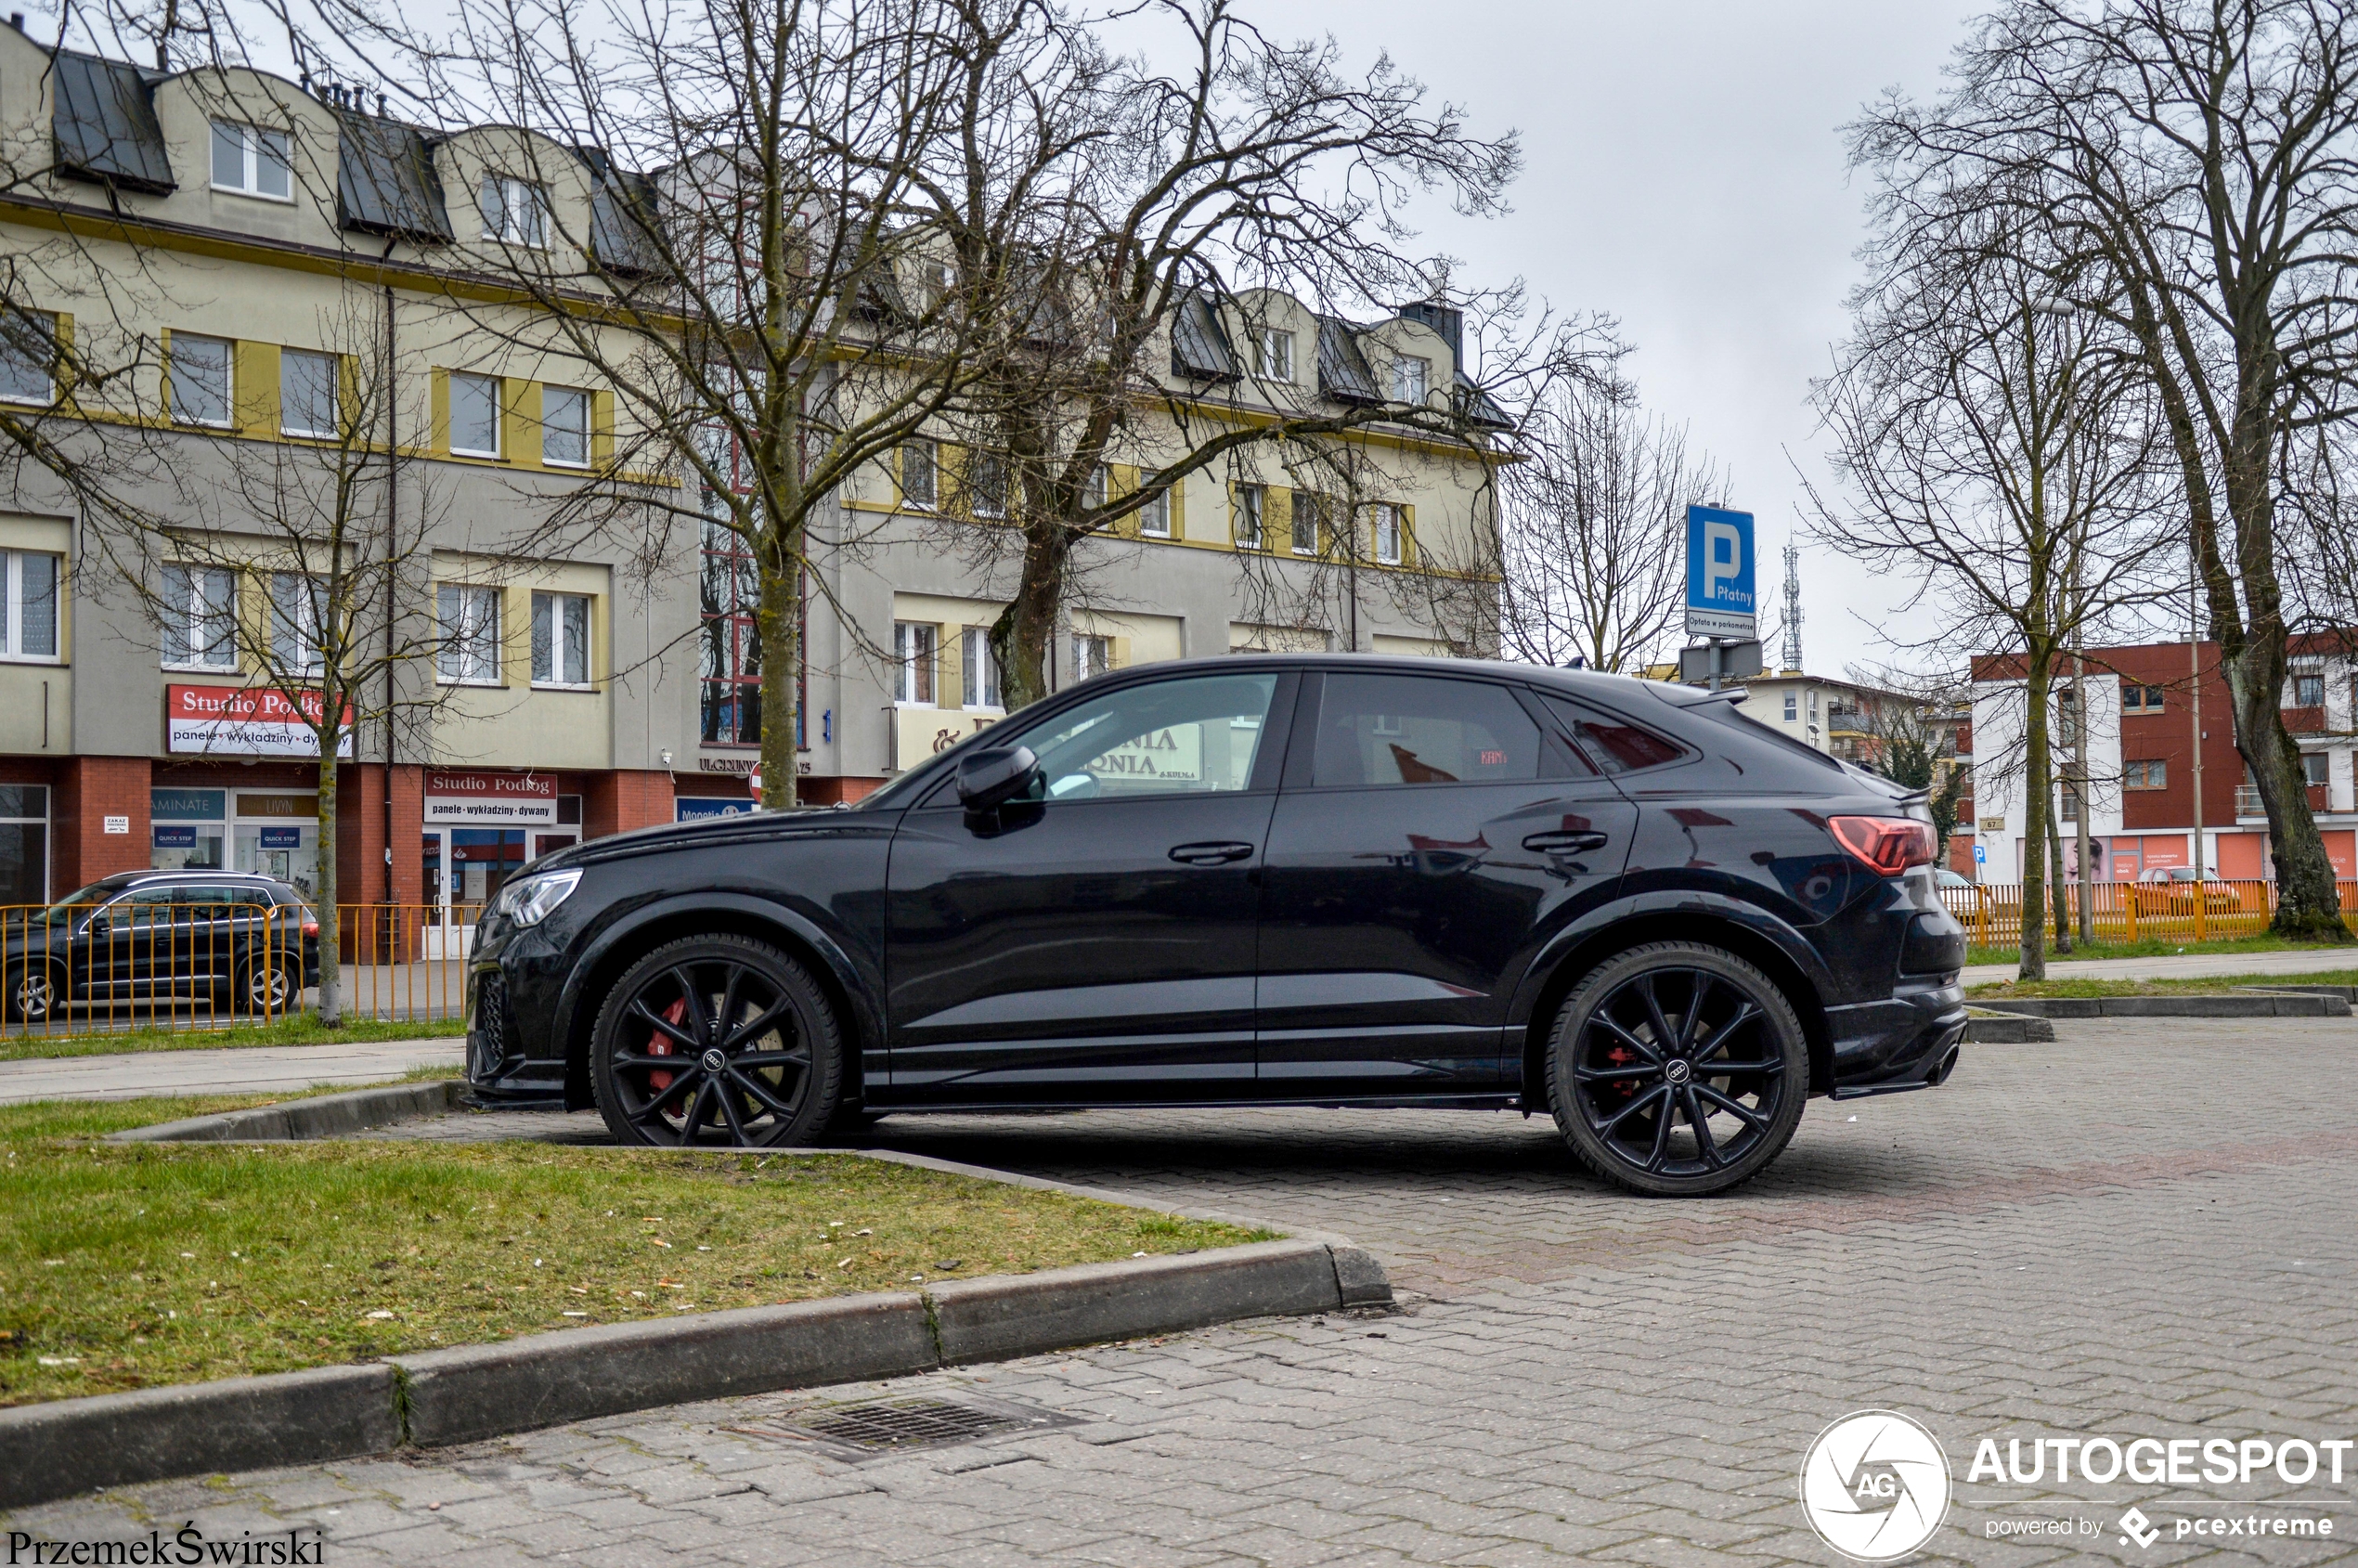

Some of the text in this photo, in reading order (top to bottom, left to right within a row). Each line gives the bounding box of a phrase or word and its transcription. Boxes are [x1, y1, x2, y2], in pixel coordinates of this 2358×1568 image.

[1704, 521, 1741, 599] P
[1717, 586, 1752, 607] Płatny
[1690, 616, 1710, 627] Opłata
[1718, 619, 1753, 631] parkometrze
[183, 692, 327, 717] Studio Podłó
[174, 730, 216, 743] panele
[227, 731, 294, 745] wykładziny
[433, 776, 550, 795] Studio Podłóg
[150, 799, 210, 811] AMINATE
[433, 804, 550, 817] panele wykładziny dywany
